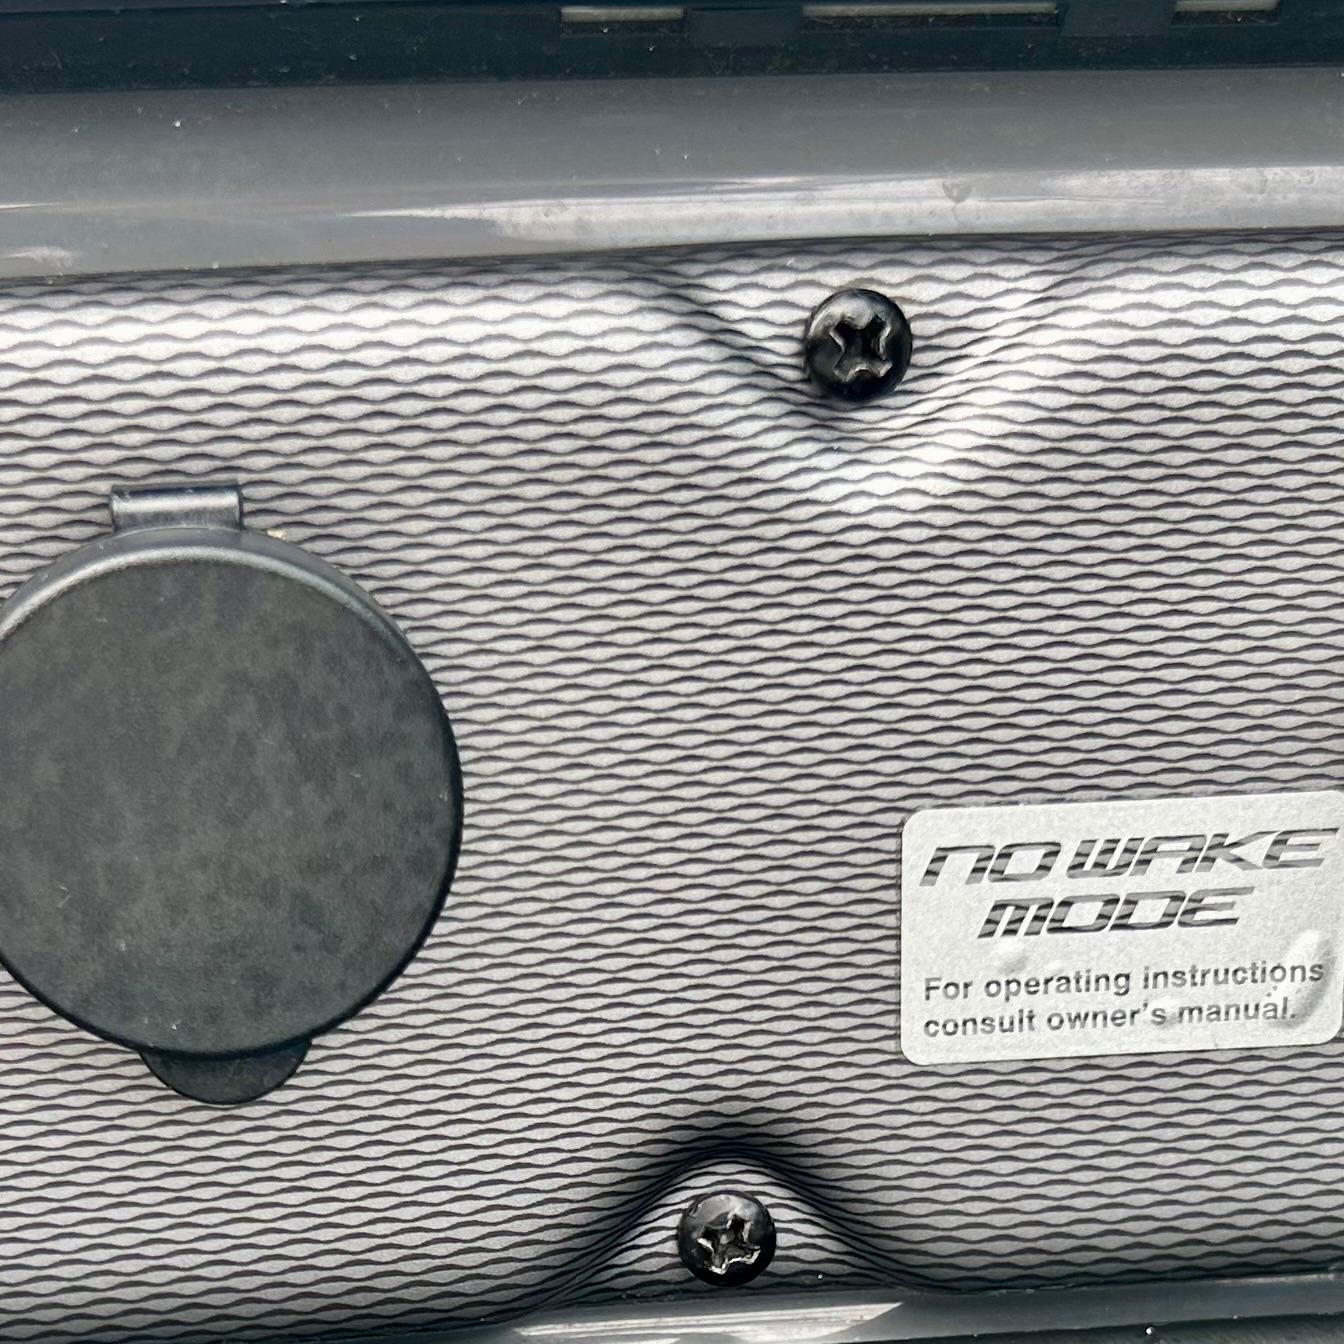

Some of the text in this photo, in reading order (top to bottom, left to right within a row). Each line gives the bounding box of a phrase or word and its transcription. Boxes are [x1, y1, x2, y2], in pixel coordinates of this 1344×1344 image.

[919, 827, 1340, 887] NO WAKE
[977, 886, 1256, 939] MODE
[924, 960, 1324, 1001] For operating instructions
[923, 996, 1298, 1038] consult owner's manual.
